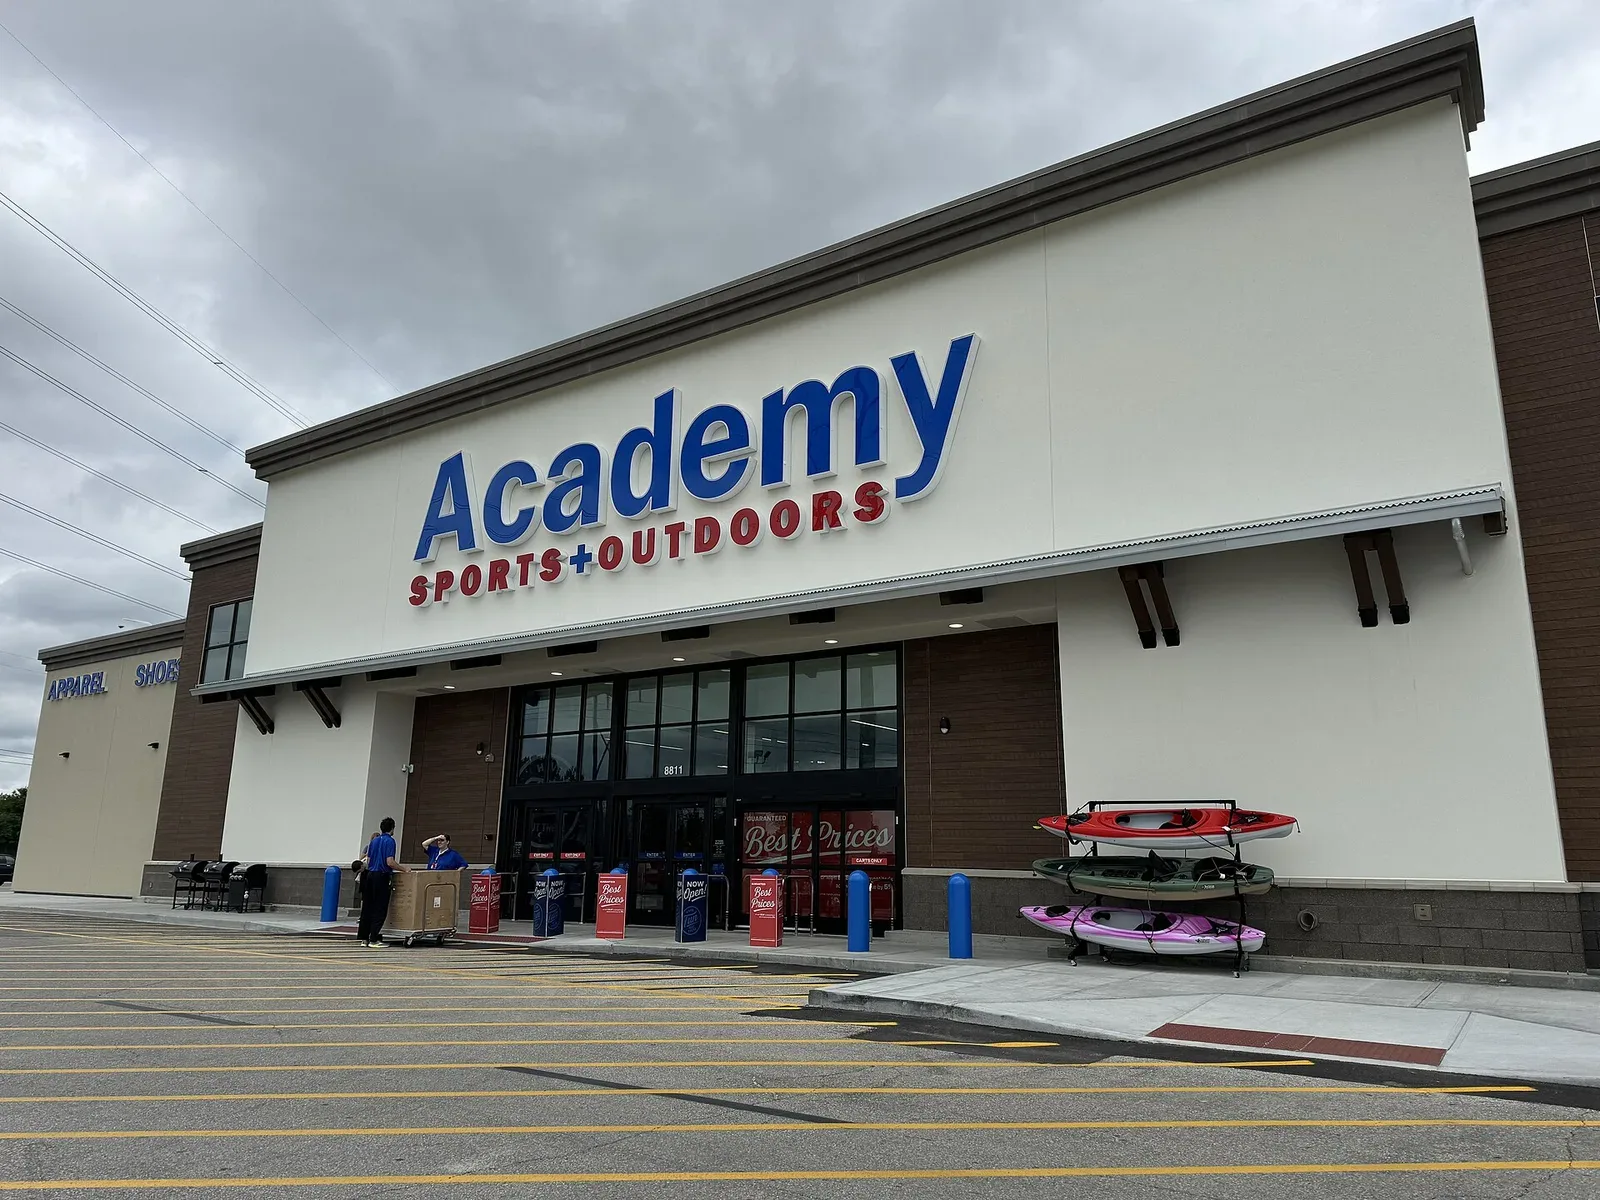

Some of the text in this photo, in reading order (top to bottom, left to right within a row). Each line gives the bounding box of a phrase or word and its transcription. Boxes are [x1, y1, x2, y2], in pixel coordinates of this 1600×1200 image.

[413, 332, 981, 564] Academy
[47, 671, 108, 701] APPAREL
[664, 765, 683, 775] 8811
[744, 825, 802, 857] Best
[807, 821, 893, 852] Prices
[472, 884, 486, 893] Best
[602, 884, 622, 894] Best
[684, 884, 707, 901] Open!
[754, 886, 772, 898] Best
[470, 893, 488, 902] Prices
[598, 895, 624, 904] Prices
[751, 898, 775, 908] Prices
